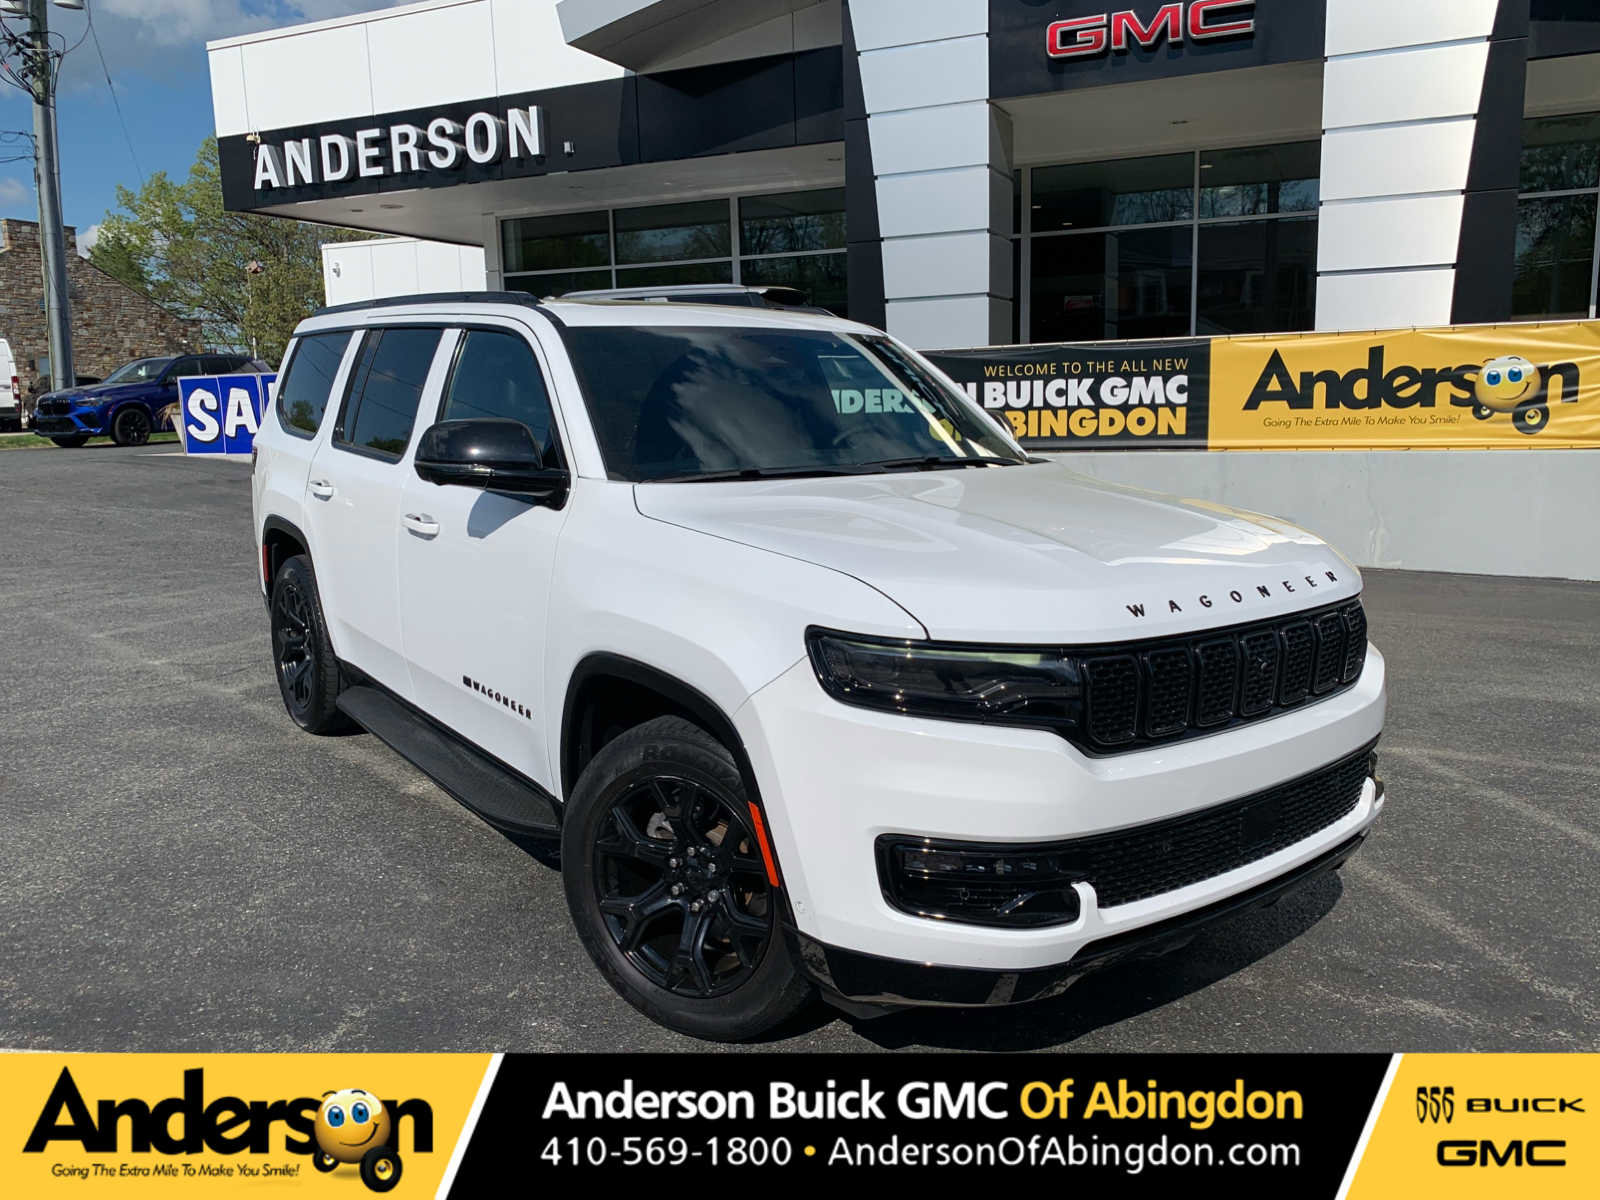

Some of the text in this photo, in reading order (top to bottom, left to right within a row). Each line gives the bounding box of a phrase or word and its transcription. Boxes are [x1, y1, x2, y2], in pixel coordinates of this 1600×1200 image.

[1046, 0, 1256, 58] GMC
[254, 105, 543, 190] ANDERSON
[984, 358, 1189, 377] WELCOME TO THE ALL NEW
[984, 377, 1089, 408] BUICK
[1100, 374, 1189, 406] GMC
[187, 382, 277, 442] SA
[1004, 406, 1187, 438] BINGDON
[1263, 414, 1461, 429] Going The Extra Mile To Make You Smile!
[1126, 571, 1338, 618] WAGONEER
[473, 680, 532, 720] WAGONEER
